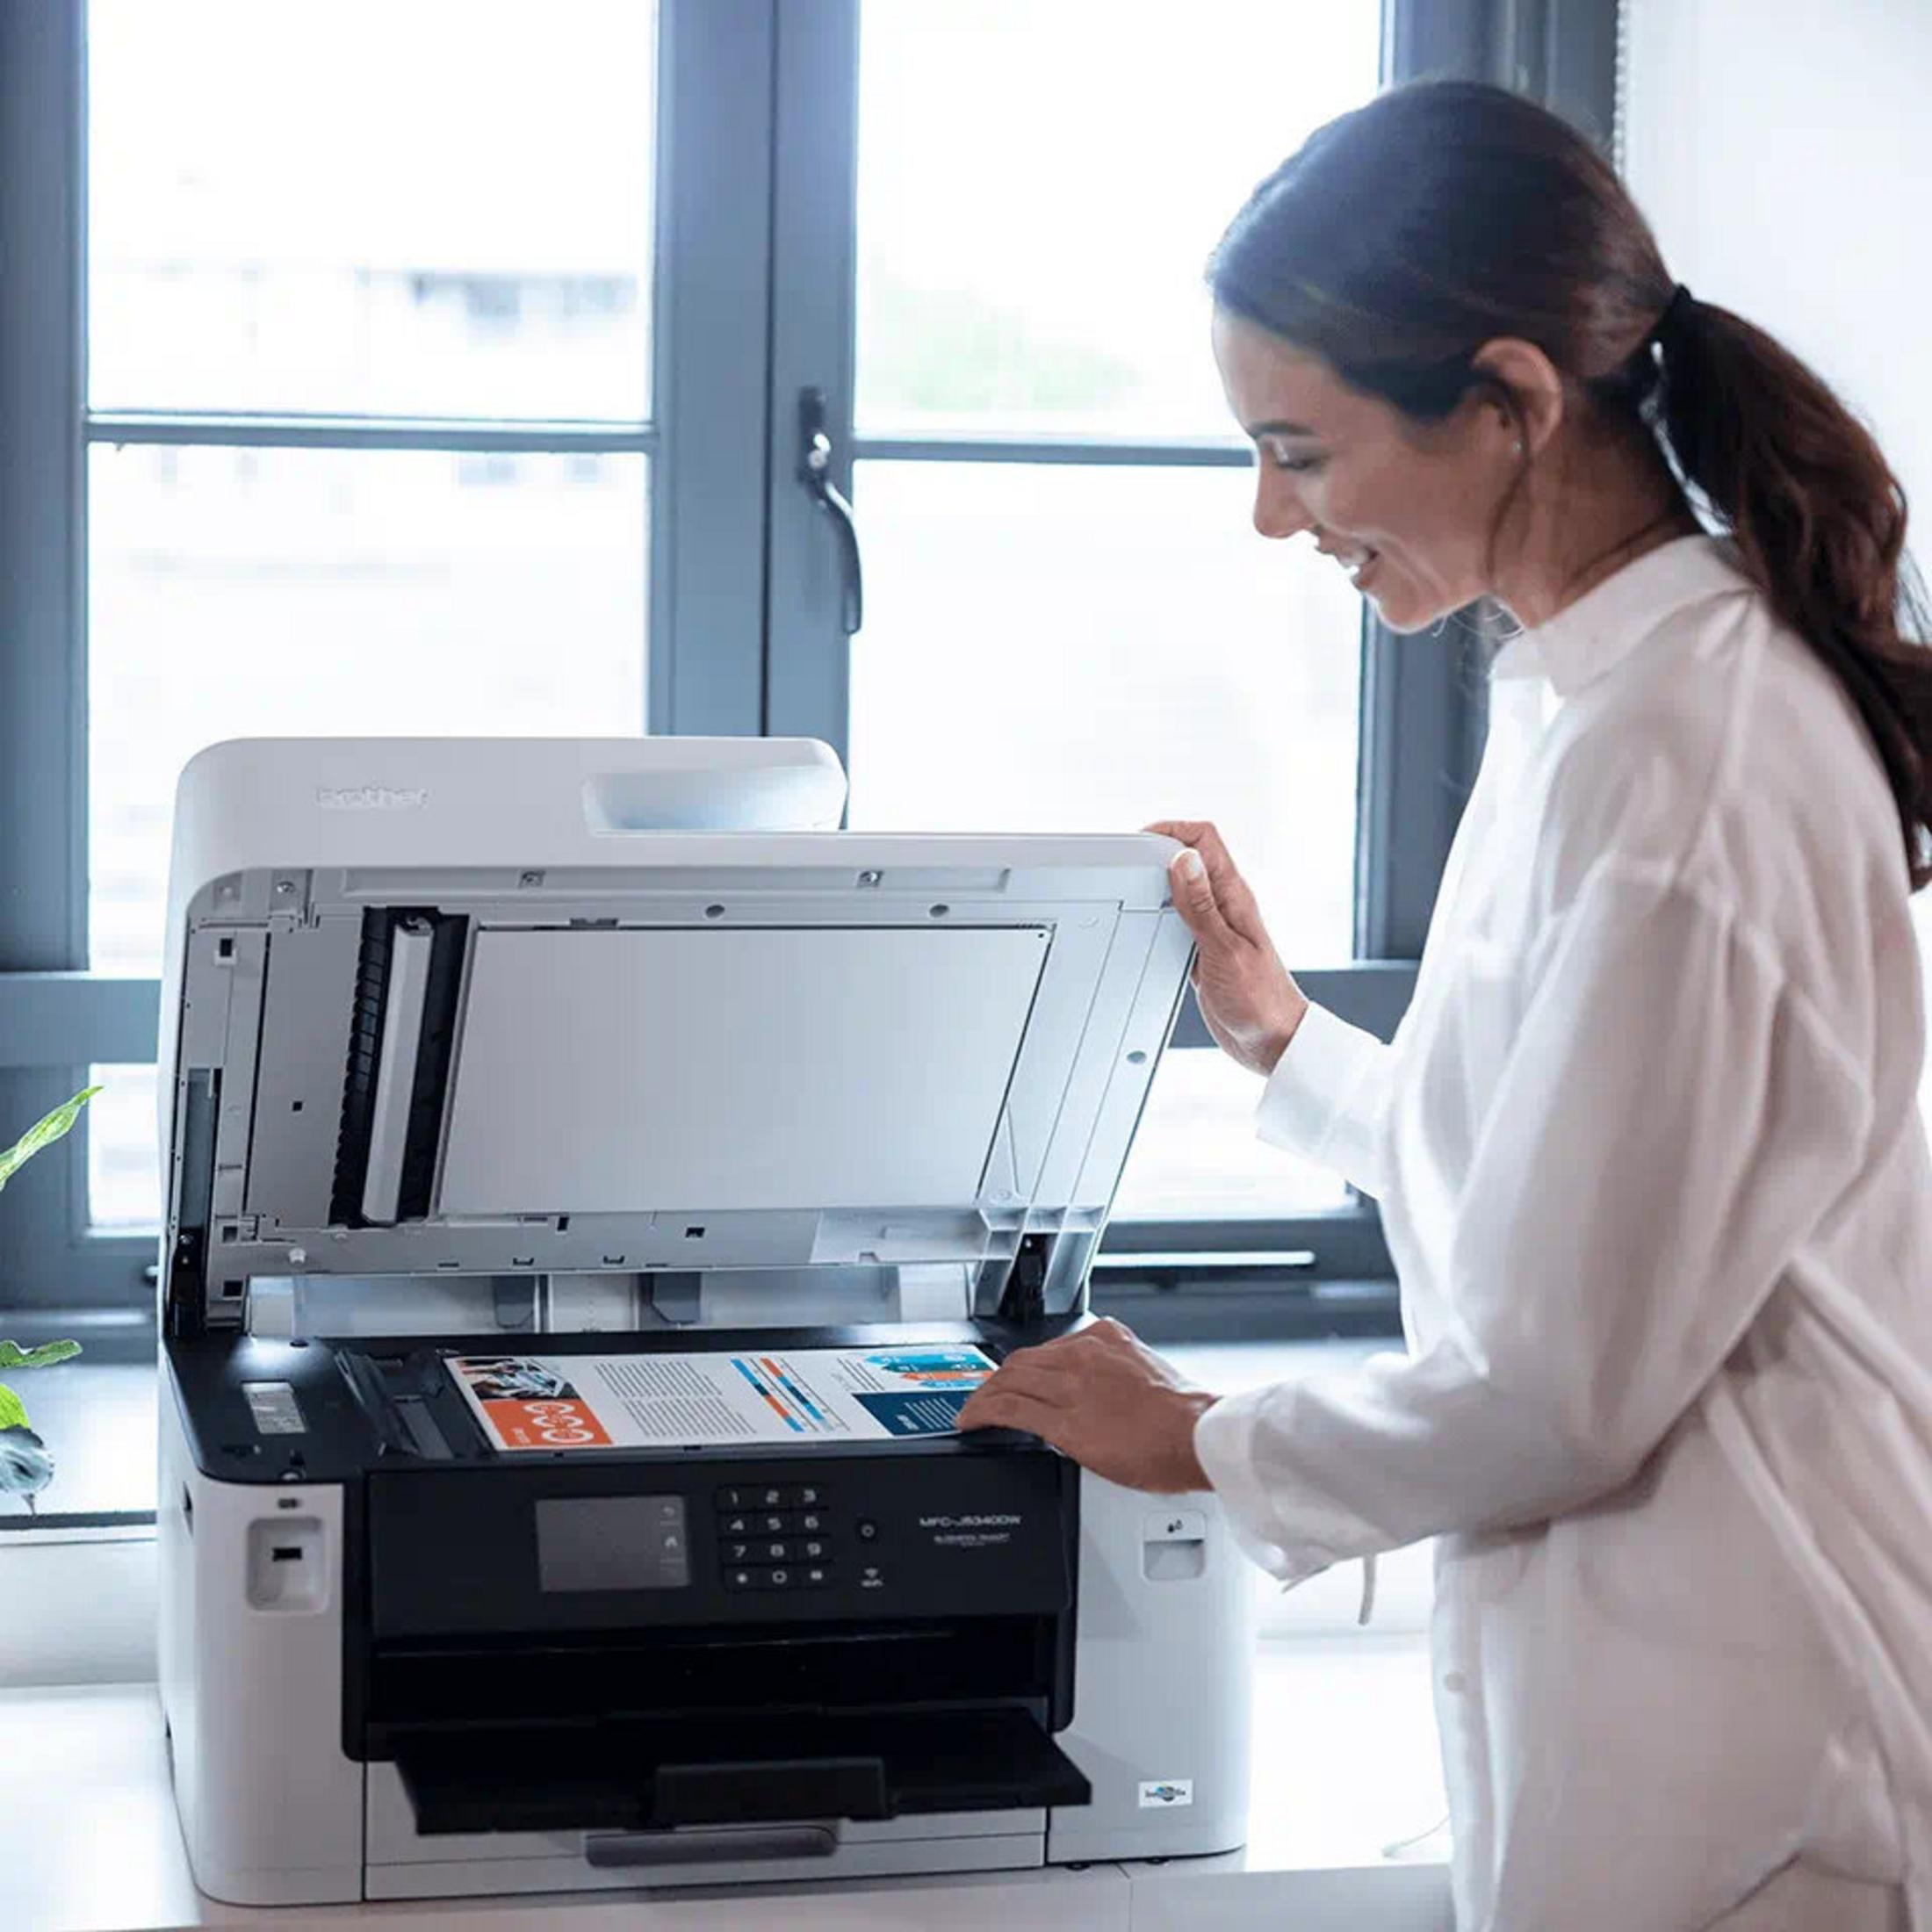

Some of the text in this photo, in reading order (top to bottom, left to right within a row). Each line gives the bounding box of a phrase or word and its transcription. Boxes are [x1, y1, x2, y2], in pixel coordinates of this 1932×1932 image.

[732, 1489, 817, 1504] 1 2 3
[731, 1515, 819, 1531] 4 5 6
[734, 1542, 822, 1558] 7 8 9
[772, 1570, 788, 1584] 0
